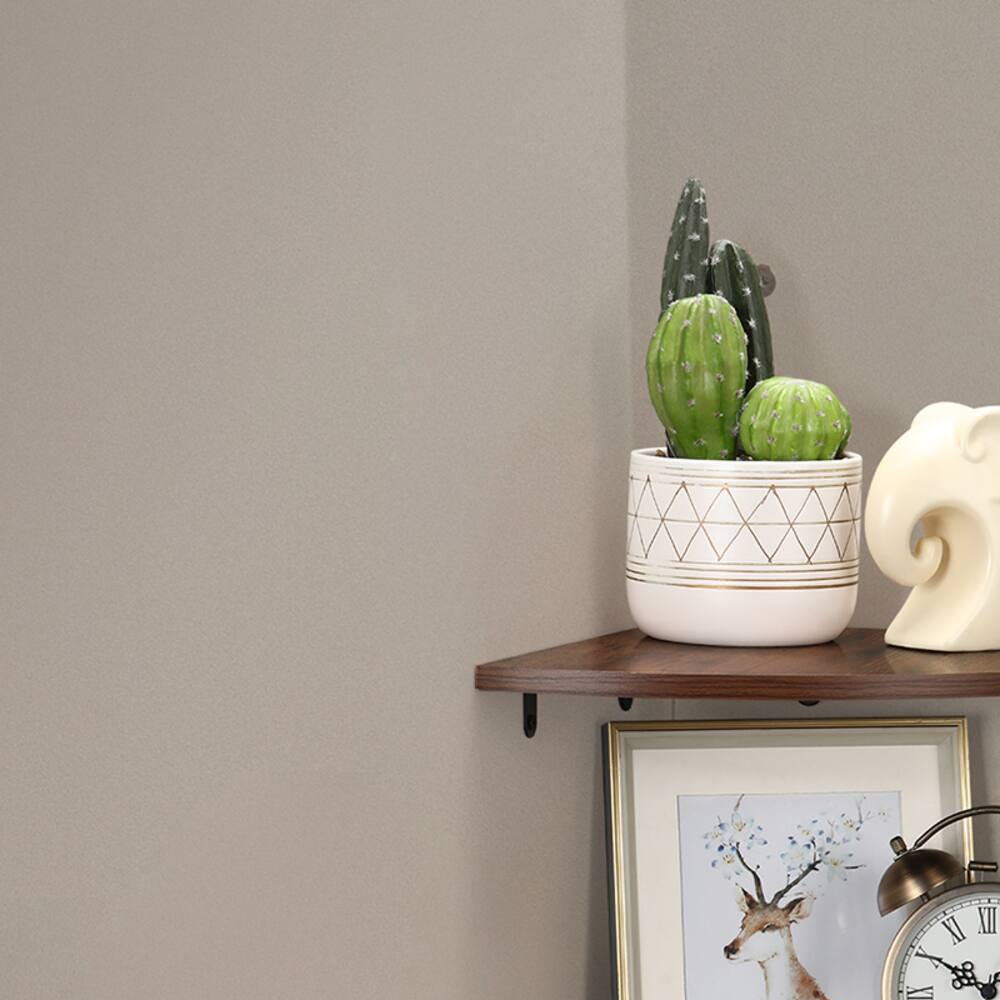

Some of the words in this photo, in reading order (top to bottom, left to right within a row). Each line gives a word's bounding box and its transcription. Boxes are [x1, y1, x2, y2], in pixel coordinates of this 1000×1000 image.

[941, 916, 966, 945] XI
[978, 907, 997, 934] XII
[907, 986, 934, 1000] IX
